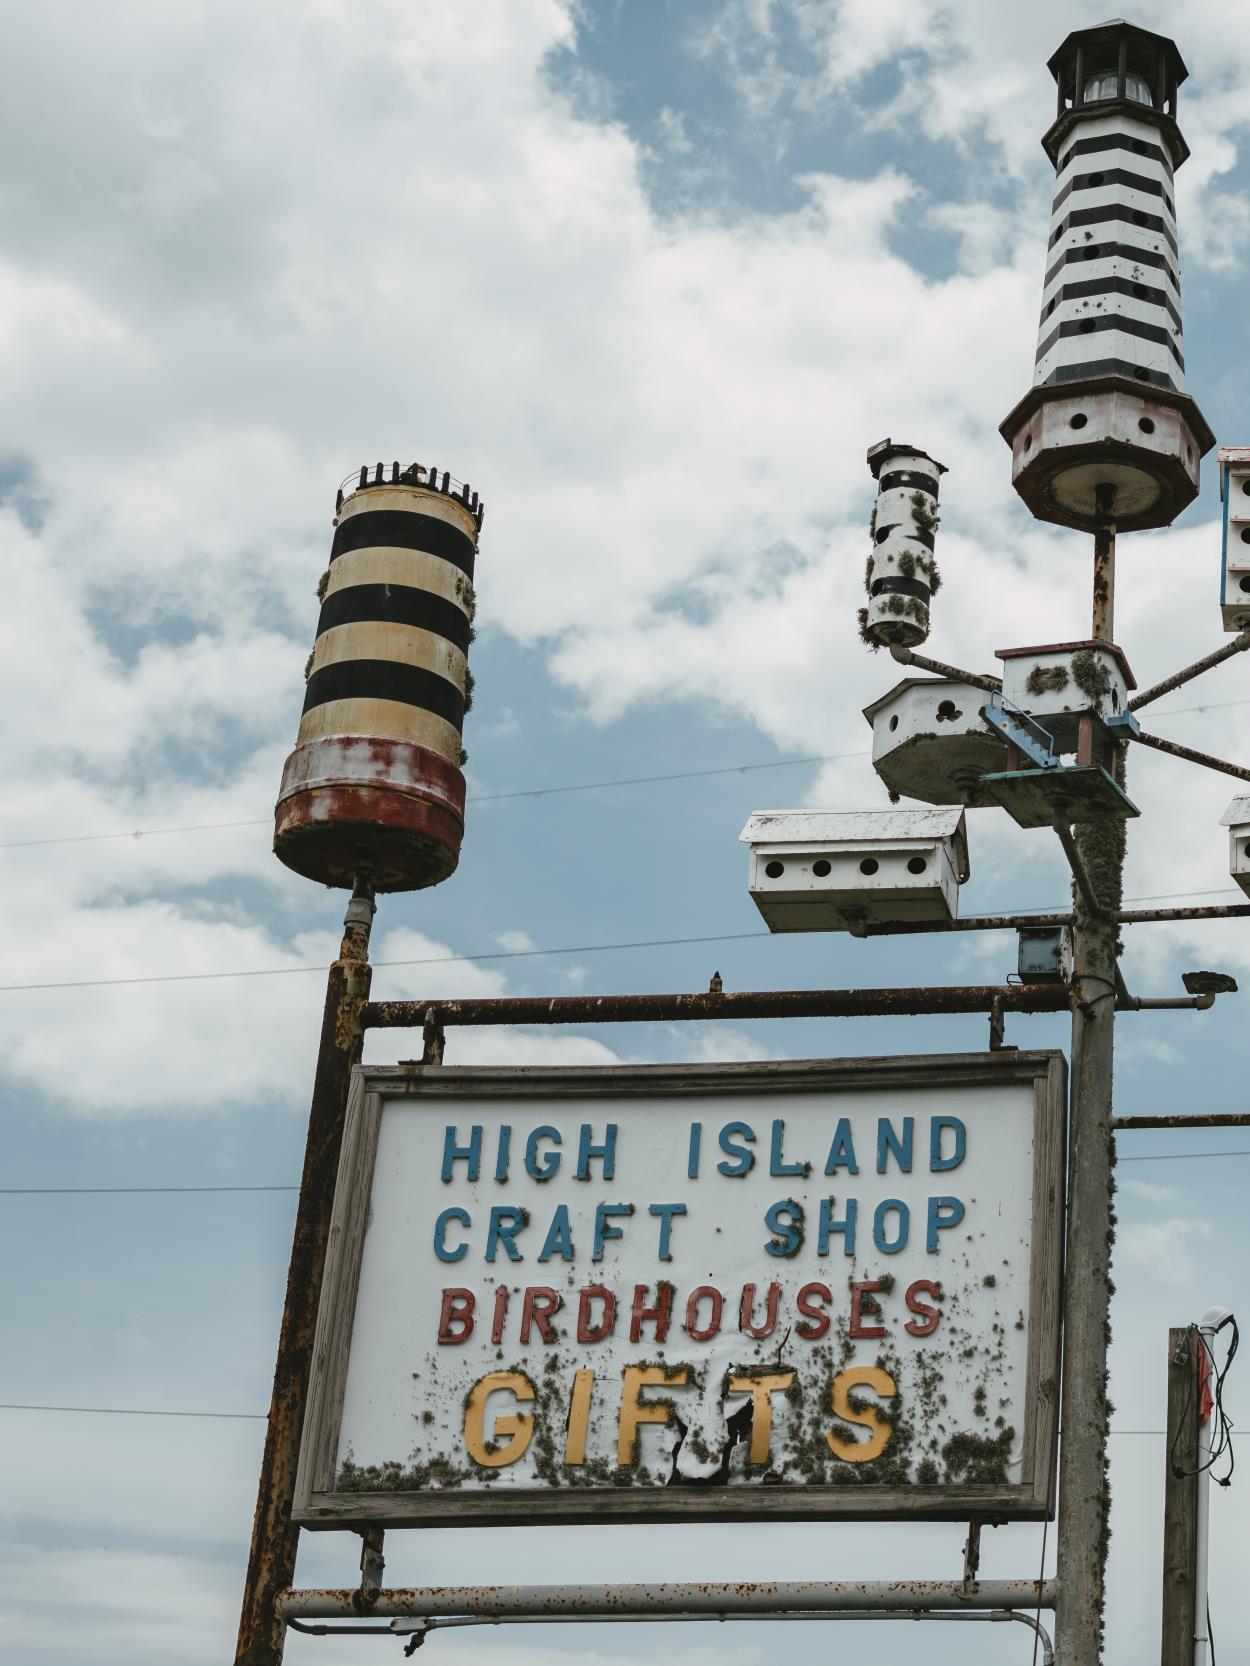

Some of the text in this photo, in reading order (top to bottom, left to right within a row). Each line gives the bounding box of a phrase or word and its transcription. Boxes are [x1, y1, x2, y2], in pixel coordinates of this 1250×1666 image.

[441, 1115, 968, 1182] HIGH ISLAND
[433, 1196, 966, 1263] CRAFT SHOP
[437, 1280, 942, 1346] BIRDHOUSES
[463, 1366, 897, 1468] GIFTS
